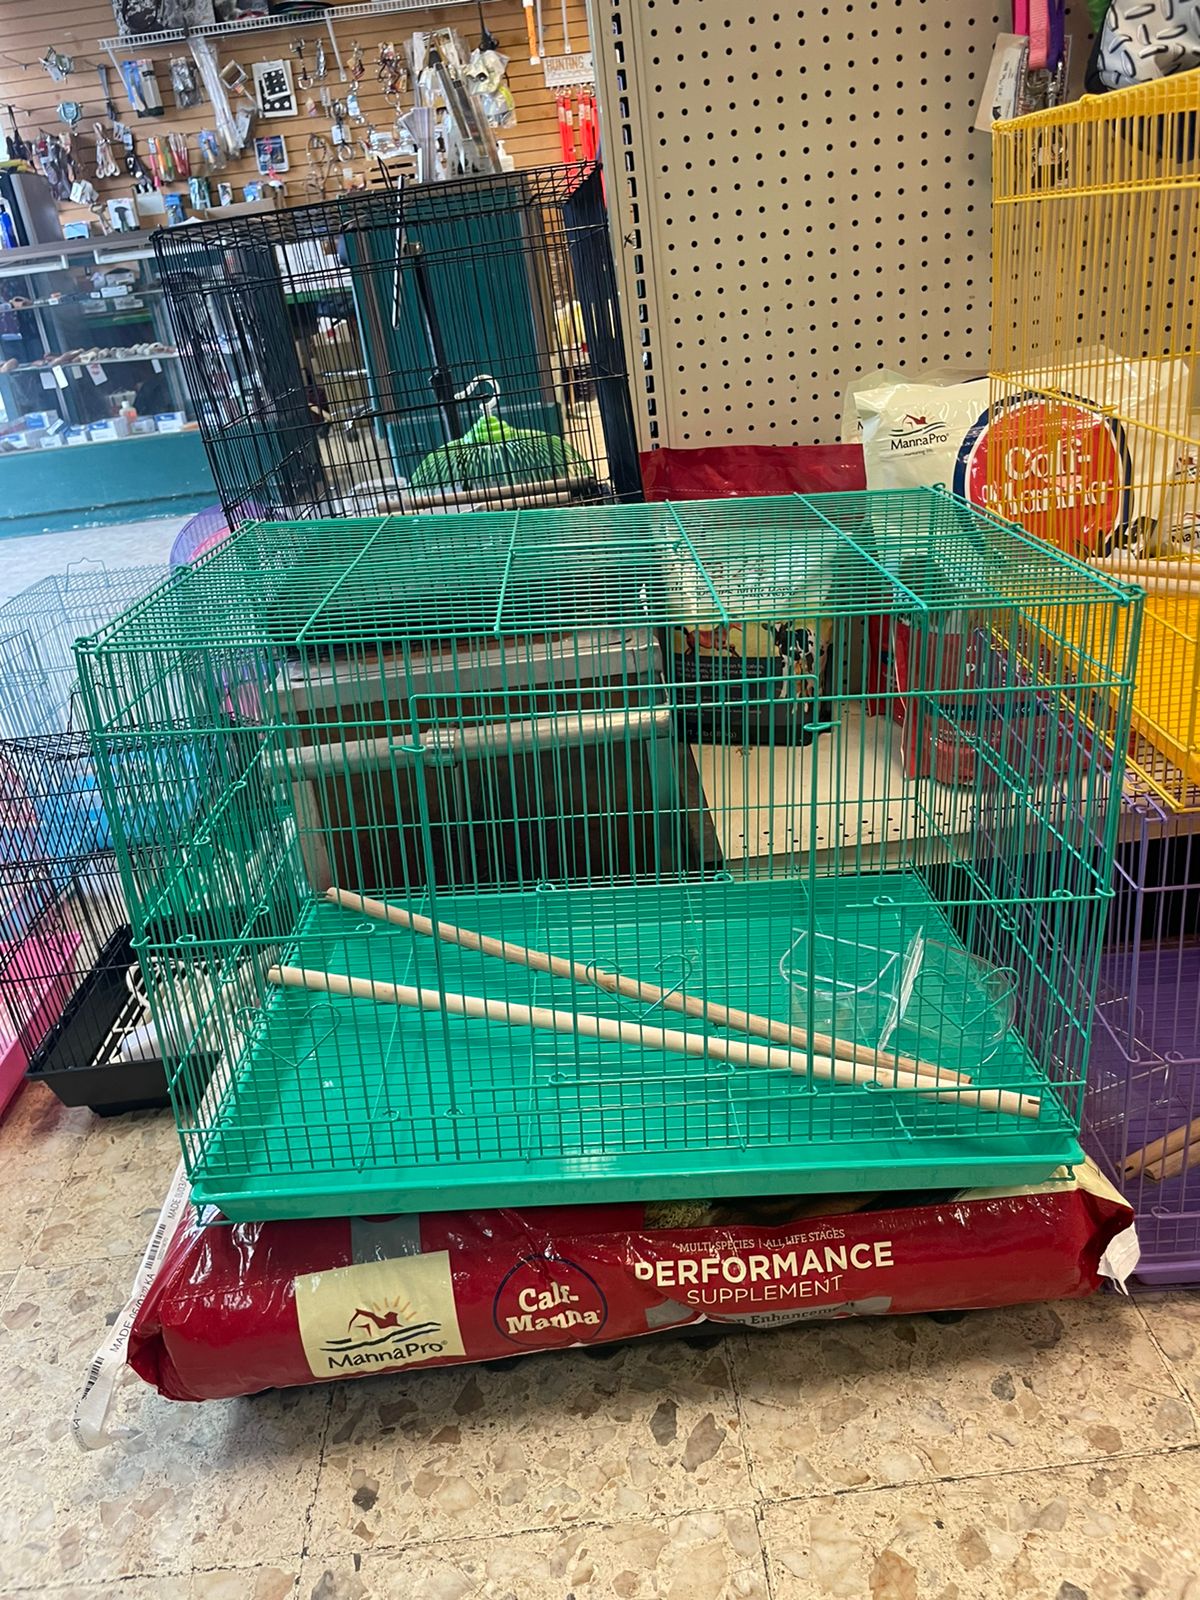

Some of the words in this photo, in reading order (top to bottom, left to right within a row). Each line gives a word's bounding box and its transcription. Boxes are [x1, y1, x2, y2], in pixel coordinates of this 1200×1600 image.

[785, 1233, 808, 1245] LIFE
[808, 1228, 846, 1242] STAGES
[634, 1240, 895, 1288] PERFORMANCE
[518, 1281, 580, 1312] Calf-
[686, 1274, 844, 1305] SUPPLEMENT
[506, 1308, 600, 1335] Manna
